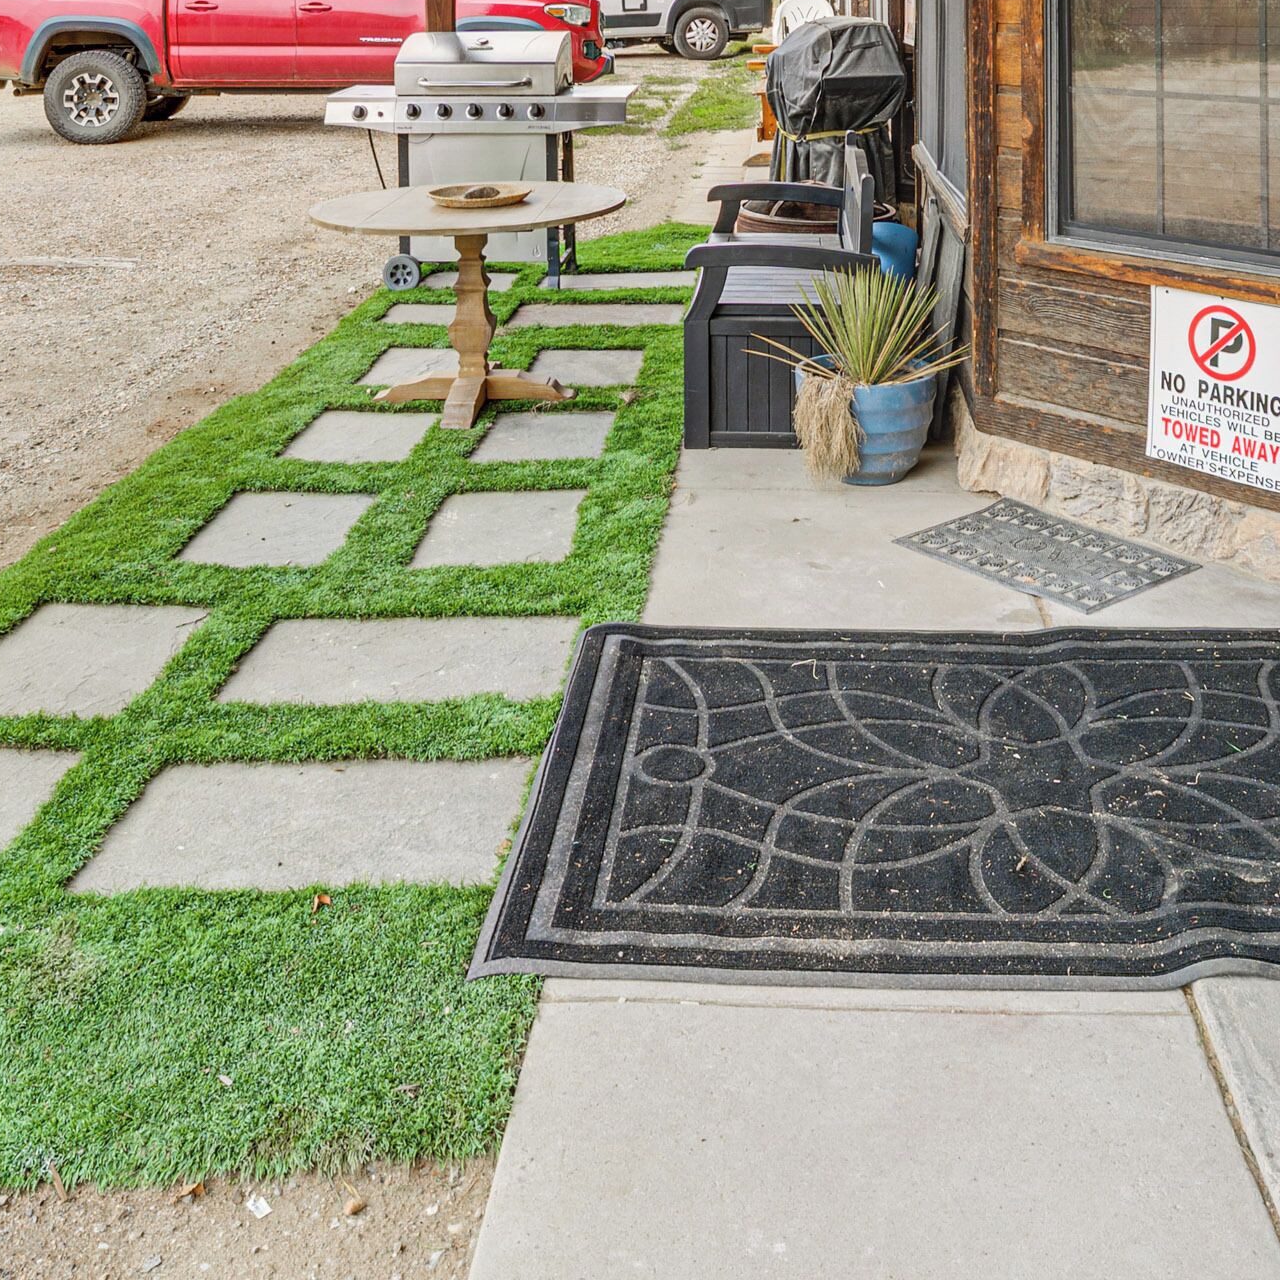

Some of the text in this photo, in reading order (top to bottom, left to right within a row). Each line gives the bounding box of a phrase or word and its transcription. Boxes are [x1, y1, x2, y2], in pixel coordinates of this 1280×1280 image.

[1161, 370, 1186, 394] NO
[1161, 404, 1221, 428] VEHICLES
[1227, 420, 1258, 438] WILL
[1171, 395, 1271, 427] UNAUTHORIZED
[1161, 417, 1280, 464] TOWED AWAY
[1156, 448, 1217, 473] OWNER'S
[1180, 443, 1259, 473] AT VEHICLE
